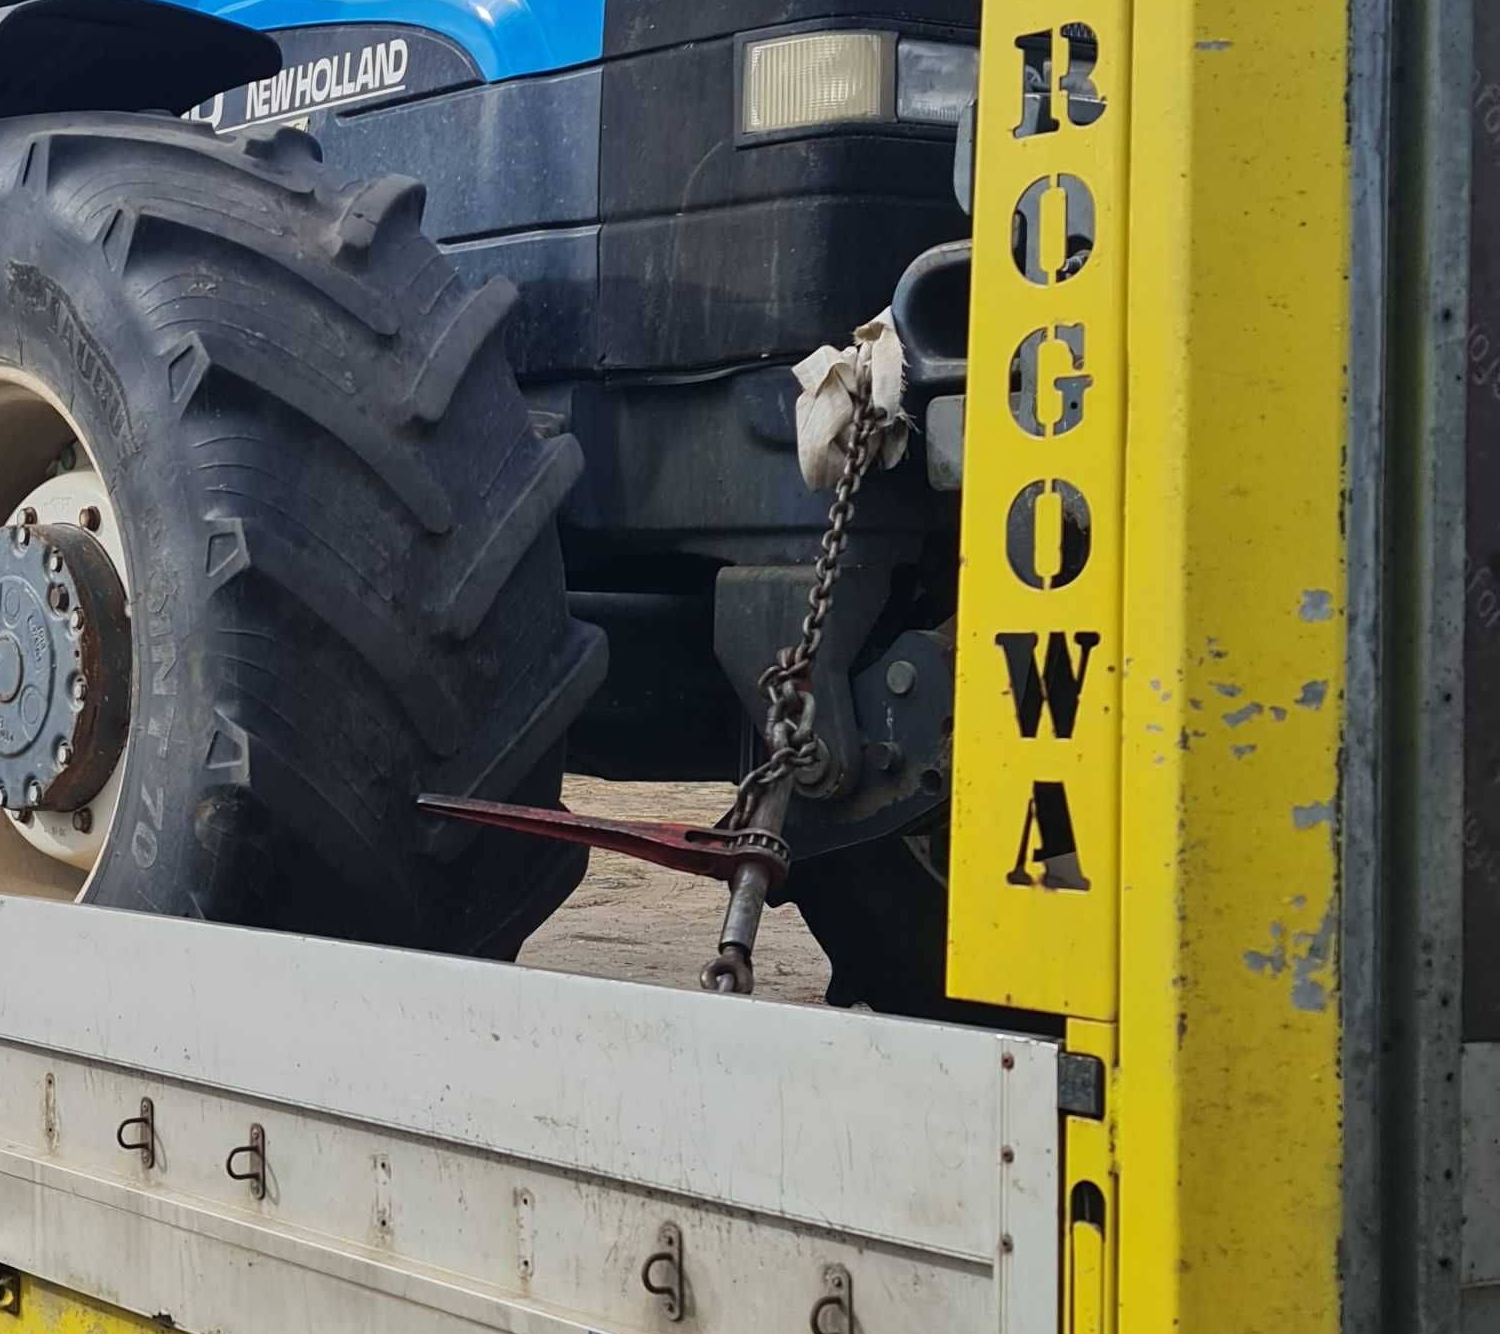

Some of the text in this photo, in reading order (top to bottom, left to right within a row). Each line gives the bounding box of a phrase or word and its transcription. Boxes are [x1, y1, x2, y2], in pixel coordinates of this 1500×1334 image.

[244, 67, 295, 121] NEW
[294, 38, 409, 108] HOLLAND
[130, 784, 164, 868] 70
